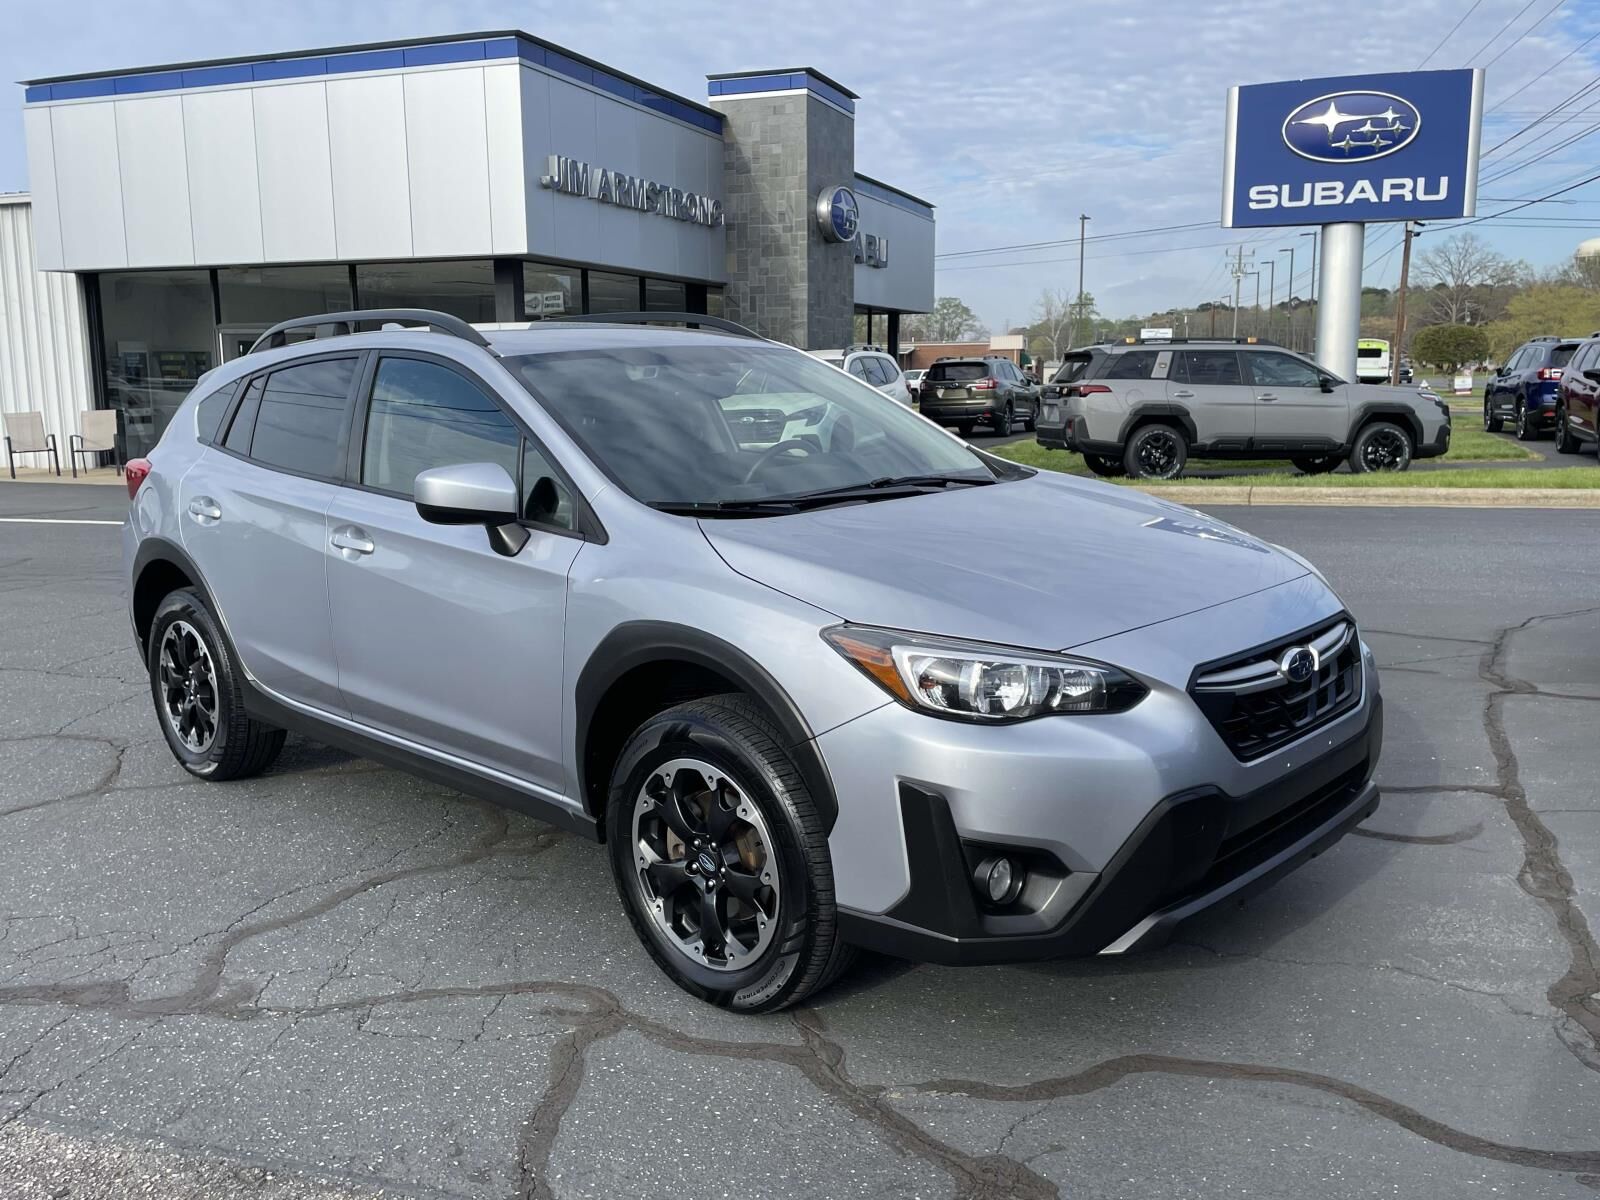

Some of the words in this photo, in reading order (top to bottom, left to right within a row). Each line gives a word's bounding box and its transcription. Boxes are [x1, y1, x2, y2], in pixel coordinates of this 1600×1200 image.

[540, 154, 590, 197] JIM
[588, 168, 724, 227] ARMSTRONG
[1248, 176, 1449, 210] SUBARU
[854, 231, 889, 269] ARU
